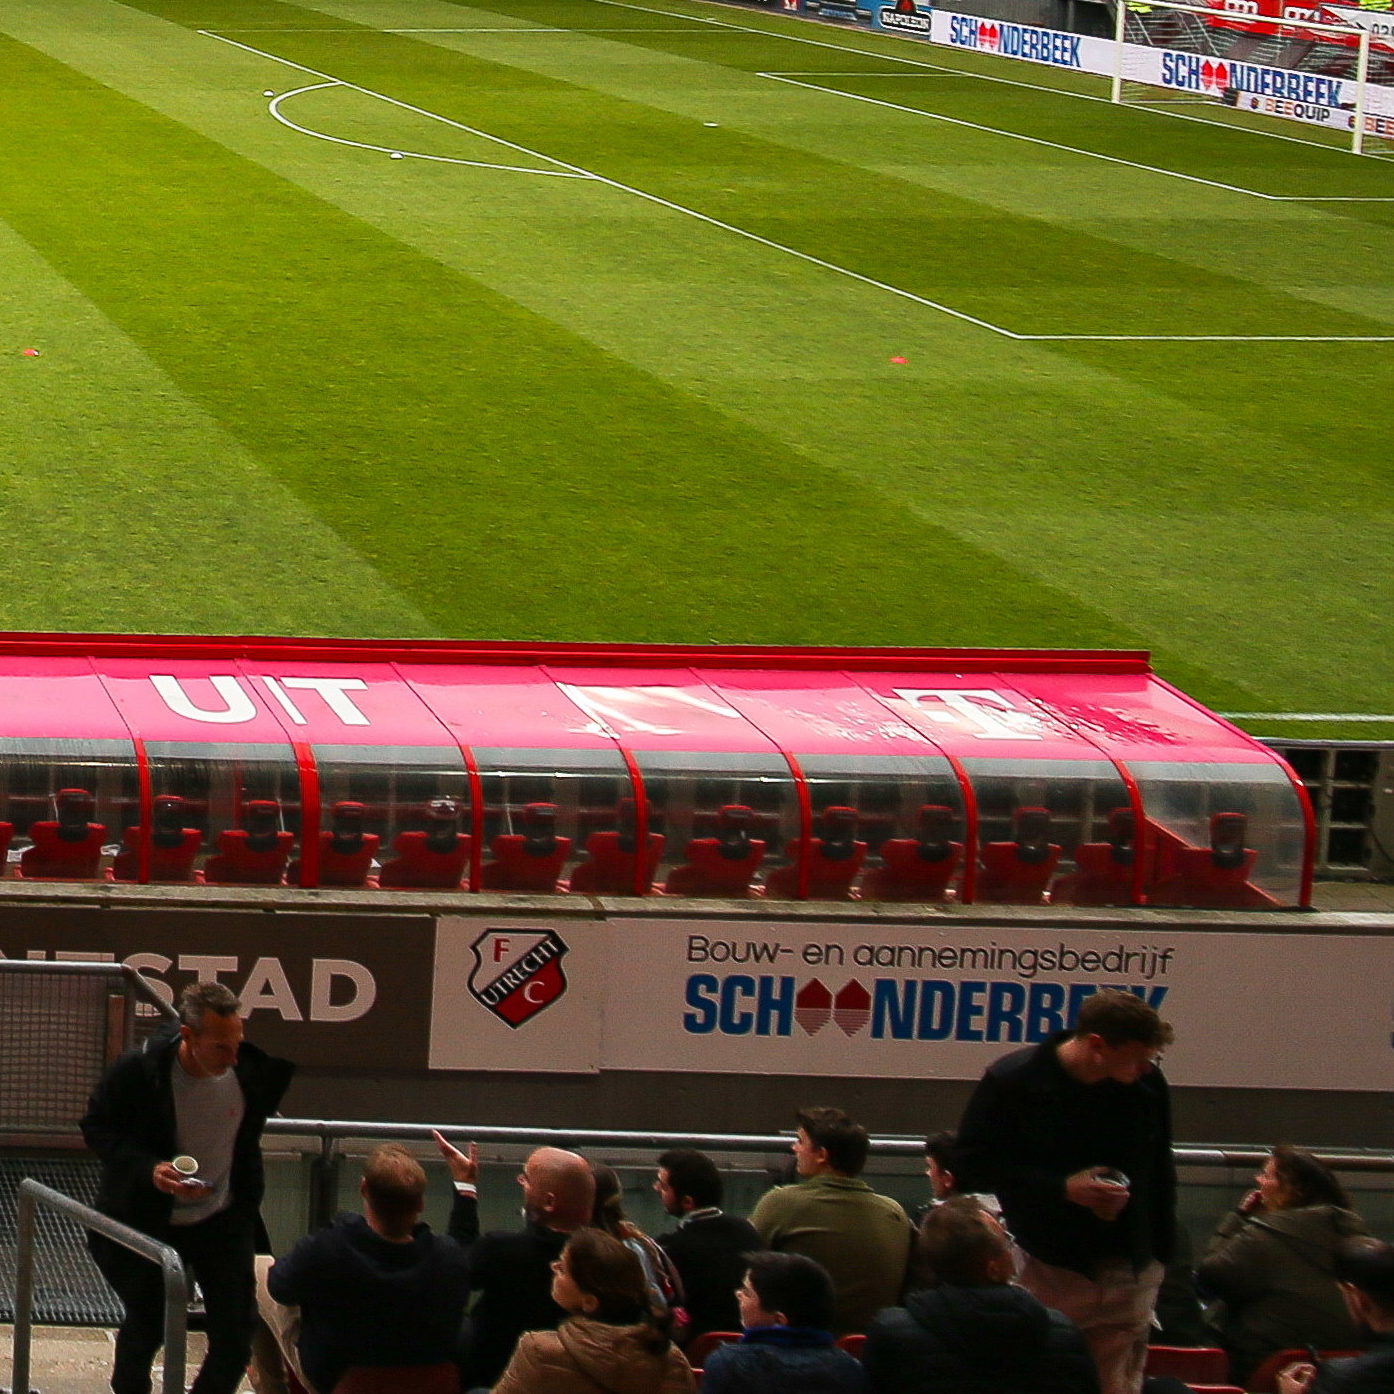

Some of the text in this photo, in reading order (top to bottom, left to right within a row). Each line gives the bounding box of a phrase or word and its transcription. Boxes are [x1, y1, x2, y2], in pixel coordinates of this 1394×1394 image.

[1266, 97, 1331, 122] BEEQUIP
[480, 937, 559, 1005] UTRECHT
[688, 935, 1175, 981] Bouw- en aannemingsbedrijf
